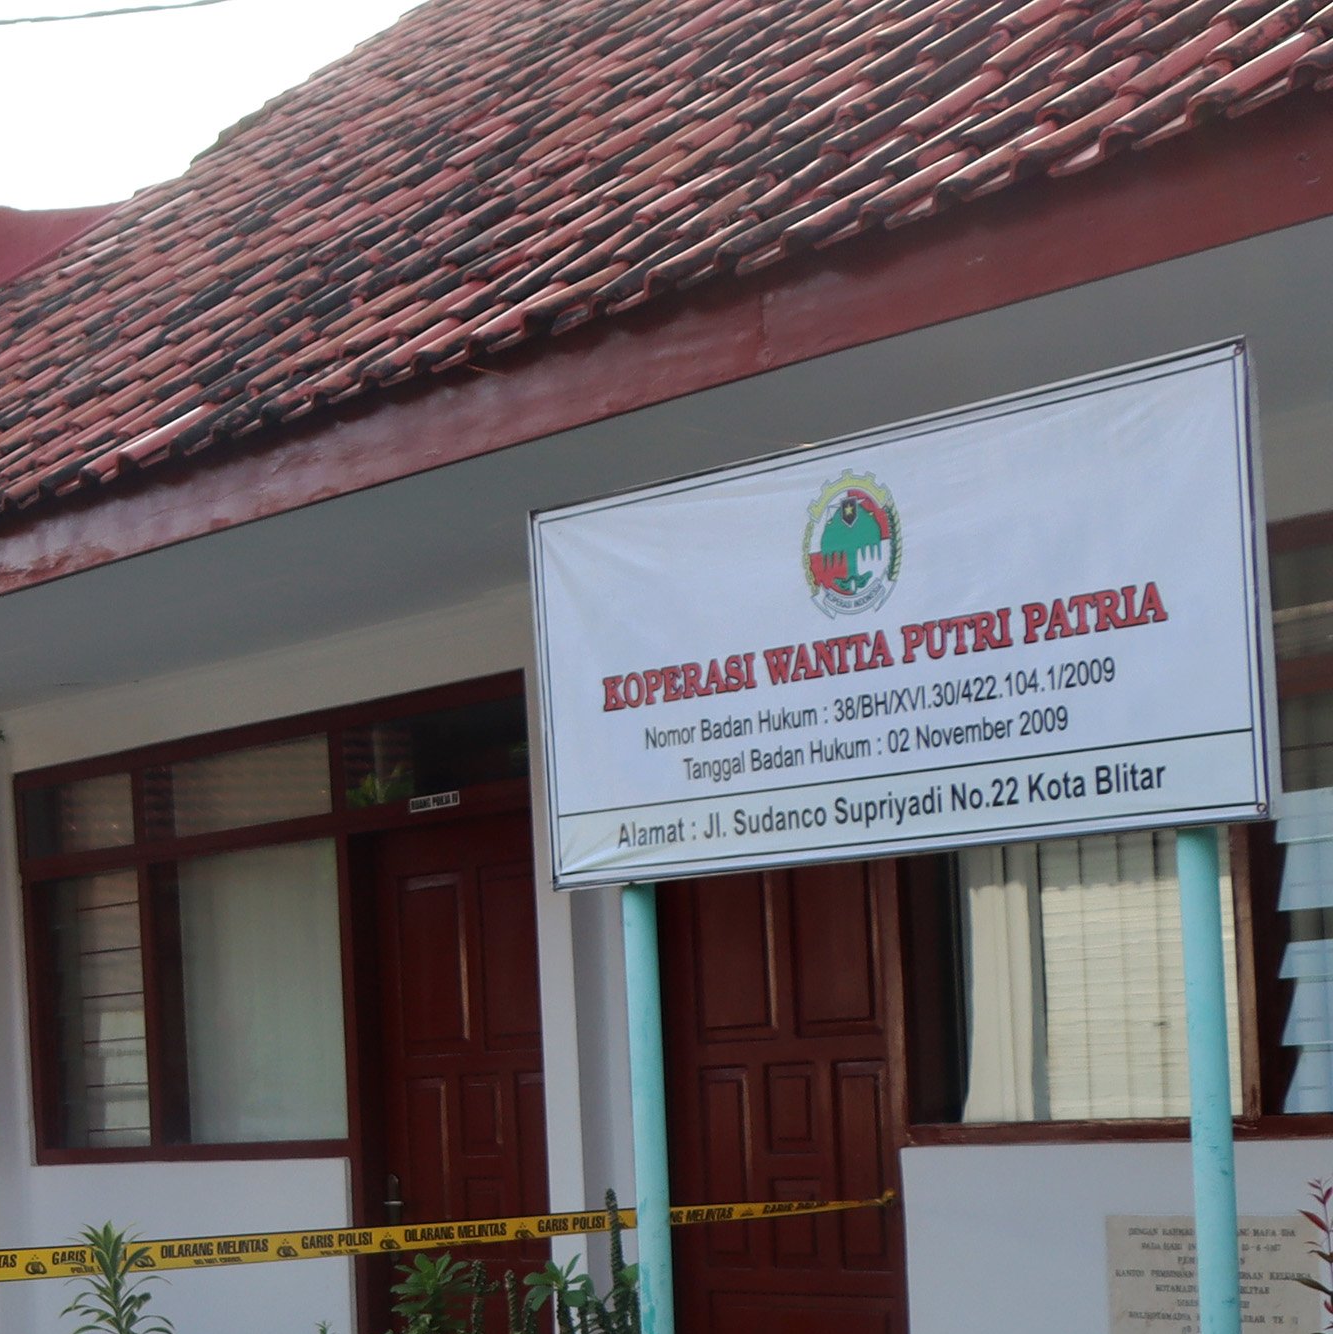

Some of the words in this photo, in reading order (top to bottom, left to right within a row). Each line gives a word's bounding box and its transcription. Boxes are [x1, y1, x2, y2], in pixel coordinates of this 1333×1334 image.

[602, 653, 757, 713] KOPERASI
[764, 630, 894, 686] WANITA
[901, 608, 1012, 664] PUTRI
[1023, 581, 1169, 643] PATRIA
[645, 724, 696, 750] Nomor
[701, 716, 754, 743] Badan
[758, 707, 818, 733] Hukum
[834, 656, 1116, 723] 38/BH/XVI.30/422.104.1/2009
[683, 751, 746, 783] Tanggal
[751, 745, 805, 773] Badan
[810, 736, 872, 765] Hukum
[887, 728, 911, 754] 02
[916, 717, 1014, 750] November
[1019, 705, 1069, 736] 2009
[617, 818, 685, 848] Alamat
[703, 812, 727, 840] Jl.
[733, 805, 827, 836] Sudanco
[834, 786, 943, 828] Supriyadi
[950, 777, 1020, 811] No.22
[1028, 772, 1087, 802] Kota
[1095, 762, 1166, 795] Blitar
[537, 1218, 569, 1233] GARIS
[572, 1216, 605, 1230] POLISI
[686, 1207, 734, 1223] MELINTAS
[301, 1234, 334, 1249] GARIS
[338, 1232, 373, 1247] POLISI
[404, 1226, 454, 1243] DILARANG
[457, 1222, 507, 1239] MELINTAS
[52, 1250, 87, 1265] GARIS
[160, 1242, 214, 1259] DILARANG
[217, 1239, 269, 1255] MELINTAS
